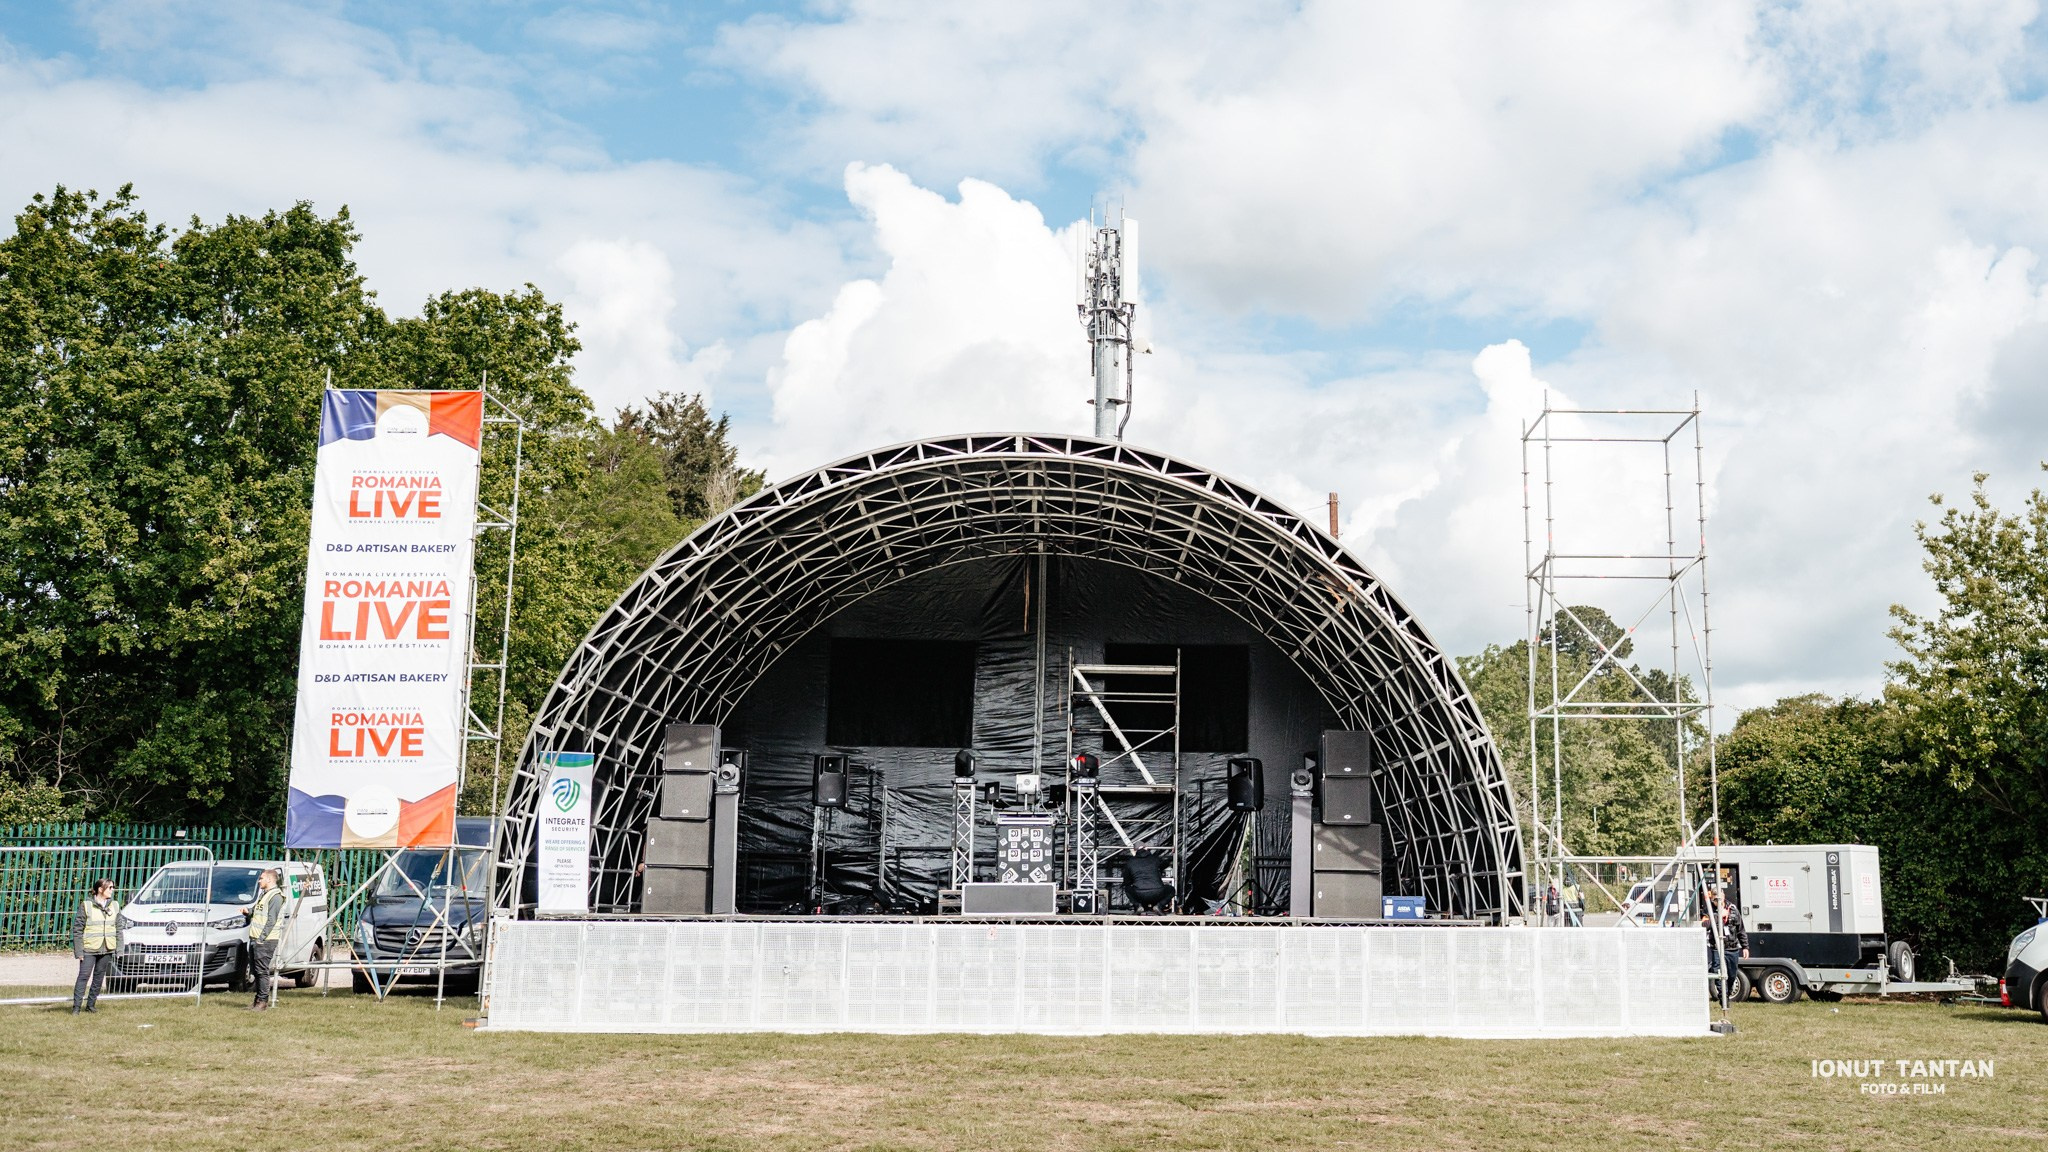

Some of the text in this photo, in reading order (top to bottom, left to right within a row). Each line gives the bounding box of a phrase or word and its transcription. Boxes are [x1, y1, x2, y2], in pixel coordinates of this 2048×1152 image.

[352, 476, 442, 488] ROMANIA
[349, 490, 442, 518] LIVE
[326, 544, 457, 553] D&D ARTISAN BAKERY
[324, 580, 451, 598] ROMANIA
[320, 600, 450, 640] LIVE
[314, 674, 448, 682] D&D ARTISAN BAKERY
[331, 713, 424, 726] ROMANIA
[329, 728, 424, 757] LIVE
